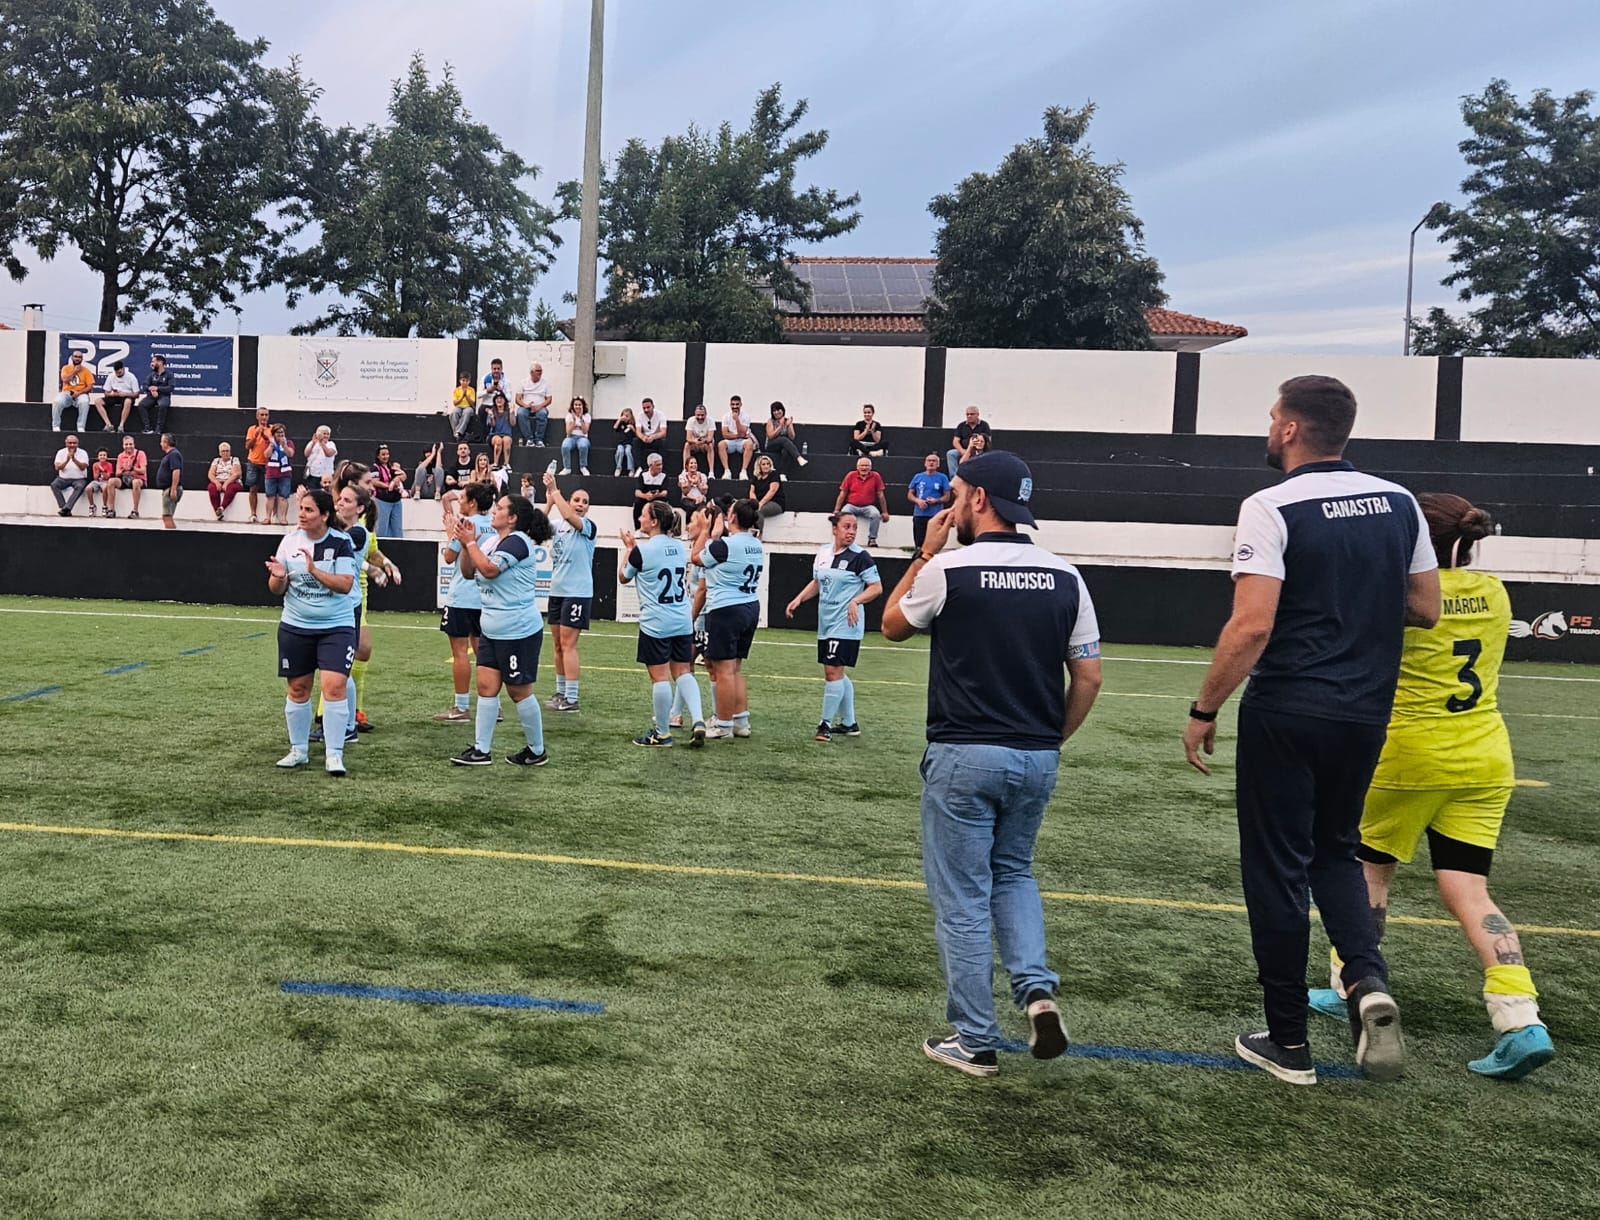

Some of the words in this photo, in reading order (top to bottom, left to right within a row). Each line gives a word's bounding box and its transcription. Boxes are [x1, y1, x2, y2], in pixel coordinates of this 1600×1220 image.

[1322, 496, 1393, 519] CANASTRA
[657, 567, 685, 604] 23
[980, 571, 1055, 590] FRANCISCO
[570, 603, 582, 617] 21
[1443, 595, 1489, 615] MÁRCIA
[829, 640, 840, 653] 17
[509, 654, 518, 670] 8
[1445, 638, 1483, 713] 3
